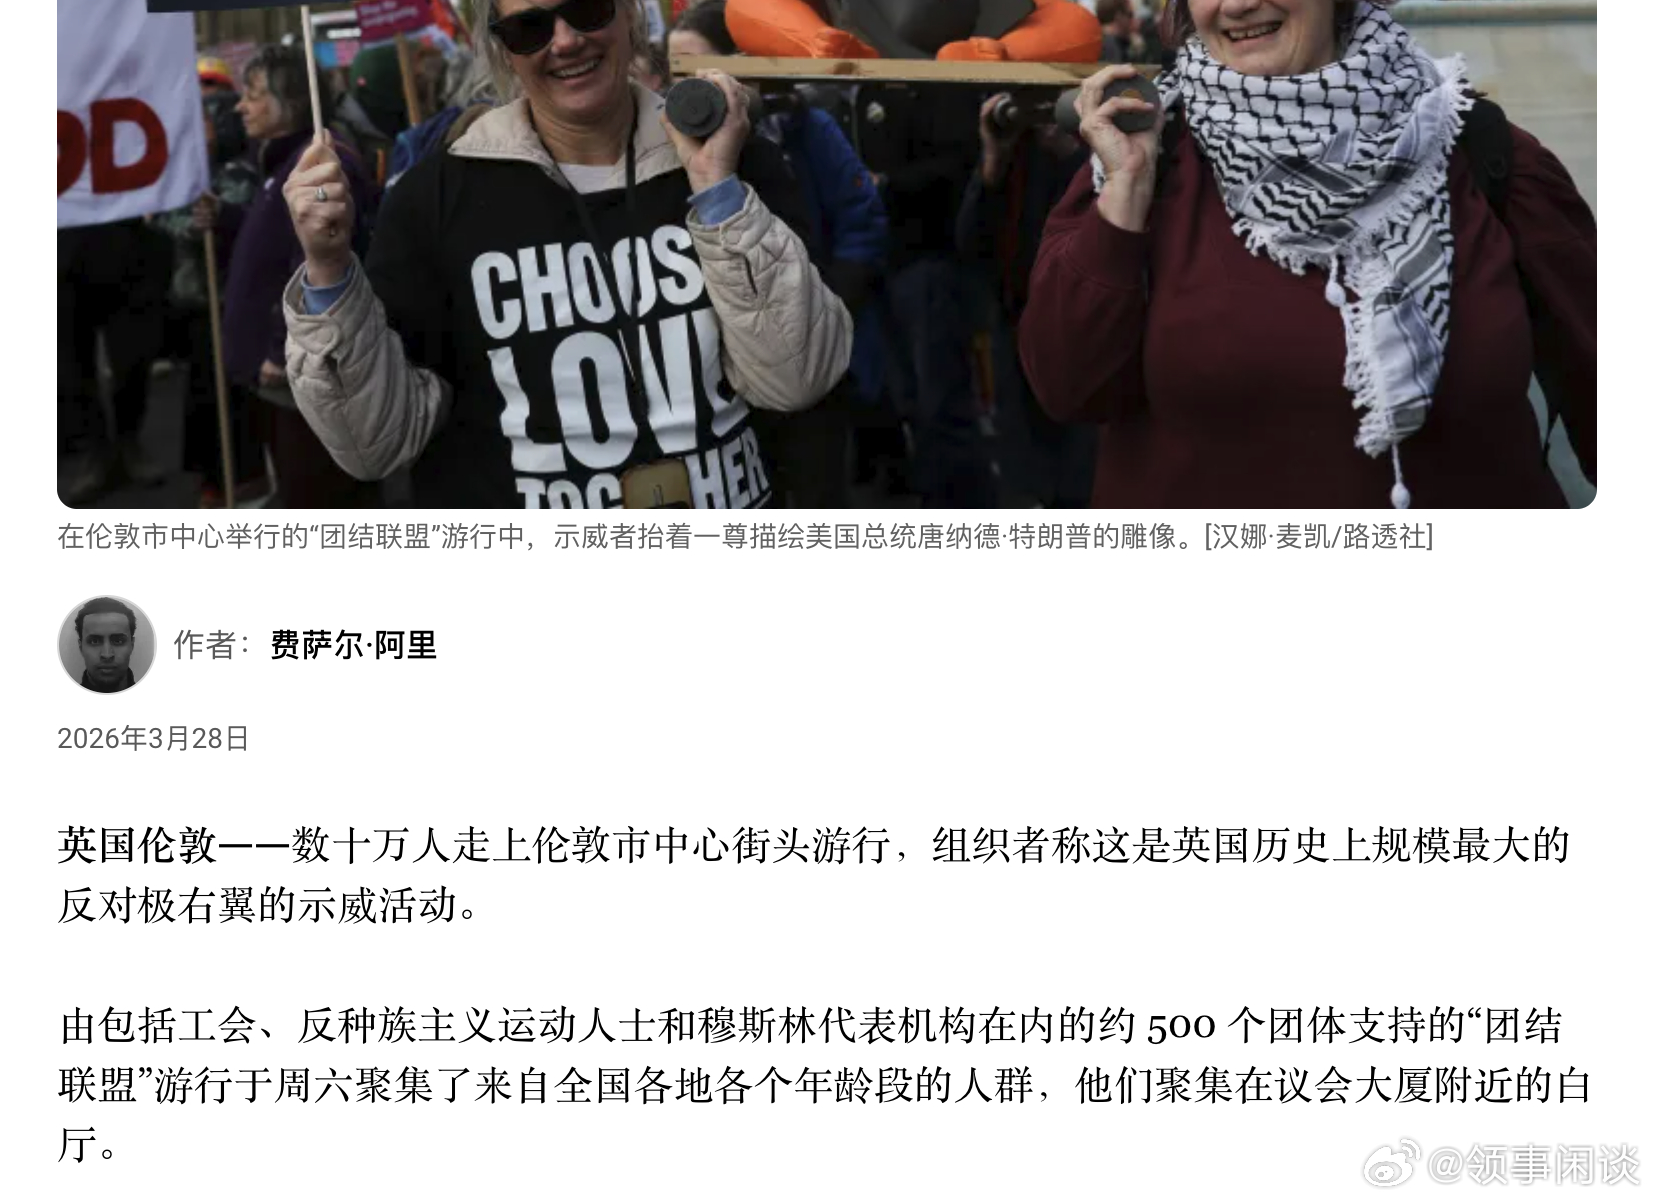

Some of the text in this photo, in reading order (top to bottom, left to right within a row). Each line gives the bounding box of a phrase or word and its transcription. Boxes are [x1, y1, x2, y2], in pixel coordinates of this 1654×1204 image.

[471, 225, 705, 340] CHOOS
[271, 629, 437, 660] 费萨尔·阿里
[58, 725, 248, 751] 2026年3月28日
[58, 885, 472, 924] 反对极右翼的示威活动。
[63, 1006, 1135, 1044] 由包括工会、反种族主义运动人士和穆斯林代表机构在内的约
[1148, 1015, 1215, 1044] 500
[58, 1126, 112, 1163] 厅。
